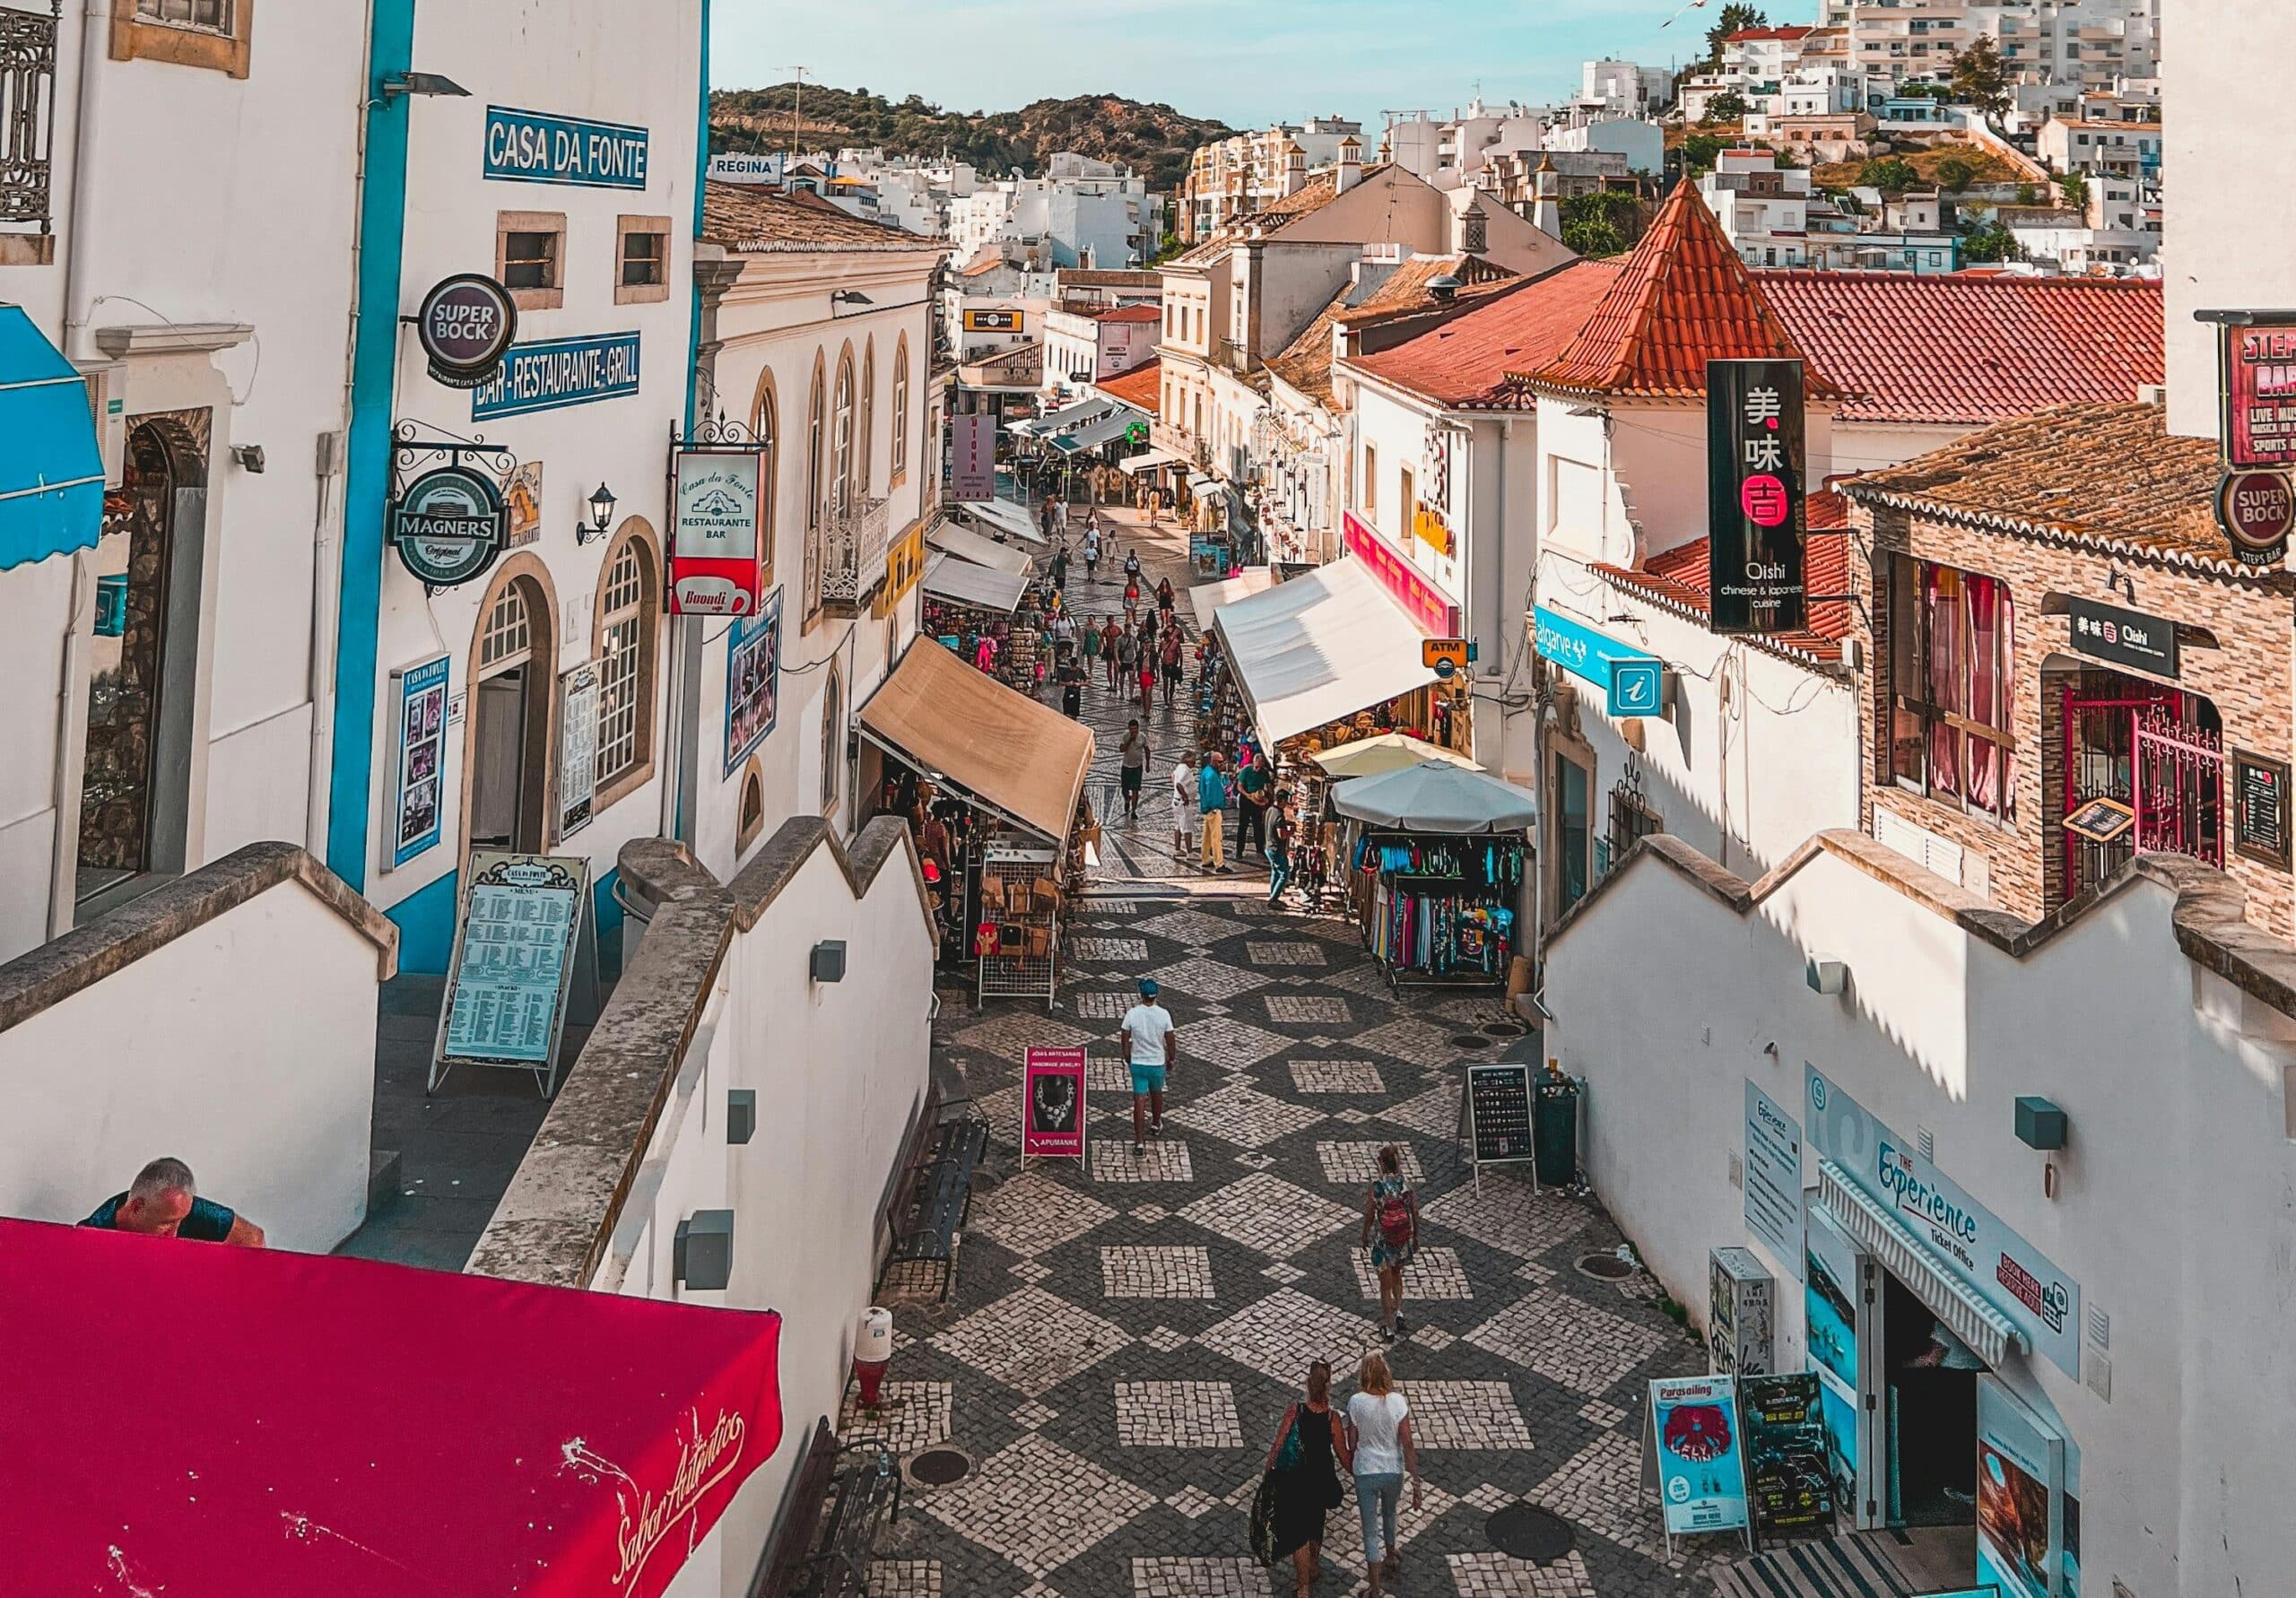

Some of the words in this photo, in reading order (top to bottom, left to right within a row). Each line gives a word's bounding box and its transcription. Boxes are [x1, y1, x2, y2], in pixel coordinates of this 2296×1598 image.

[488, 120, 548, 171] CASA
[553, 129, 583, 173] DA
[587, 135, 646, 179] FONTE
[717, 160, 772, 174] REGINA
[434, 304, 494, 324] SUPER
[436, 322, 489, 340] BOCK
[2250, 407, 2274, 422] LIVE
[2253, 439, 2287, 452] SPORTS
[679, 476, 707, 497] Casa
[708, 472, 723, 483] da
[725, 473, 753, 500] Fonte
[2239, 489, 2286, 508] SUPER
[682, 517, 752, 528] RESTAURANTE
[2243, 505, 2285, 523] BOCK
[401, 517, 491, 537] MAGNERS
[706, 530, 726, 539] BAR
[425, 544, 463, 560] Original
[2240, 551, 2266, 565] STEPS
[2266, 547, 2282, 563] BAR
[1746, 561, 1786, 580] Oishi
[685, 590, 727, 605] Buondi
[1720, 584, 1758, 596] chinese
[1760, 586, 1766, 595] &
[1768, 584, 1804, 596] japanese
[1752, 599, 1781, 608] cuisine
[1537, 619, 1571, 657] algarve
[2122, 625, 2148, 646] Oishi
[1431, 642, 1460, 652] ATM
[1899, 1153, 1912, 1172] THE
[1879, 1141, 1977, 1244] Experience
[1931, 1229, 1952, 1254] Ticket
[1952, 1245, 1974, 1272] Office
[2003, 1255, 2022, 1281] BOOK
[1660, 1385, 1712, 1397] Parasailing
[612, 1489, 668, 1585] Sabor
